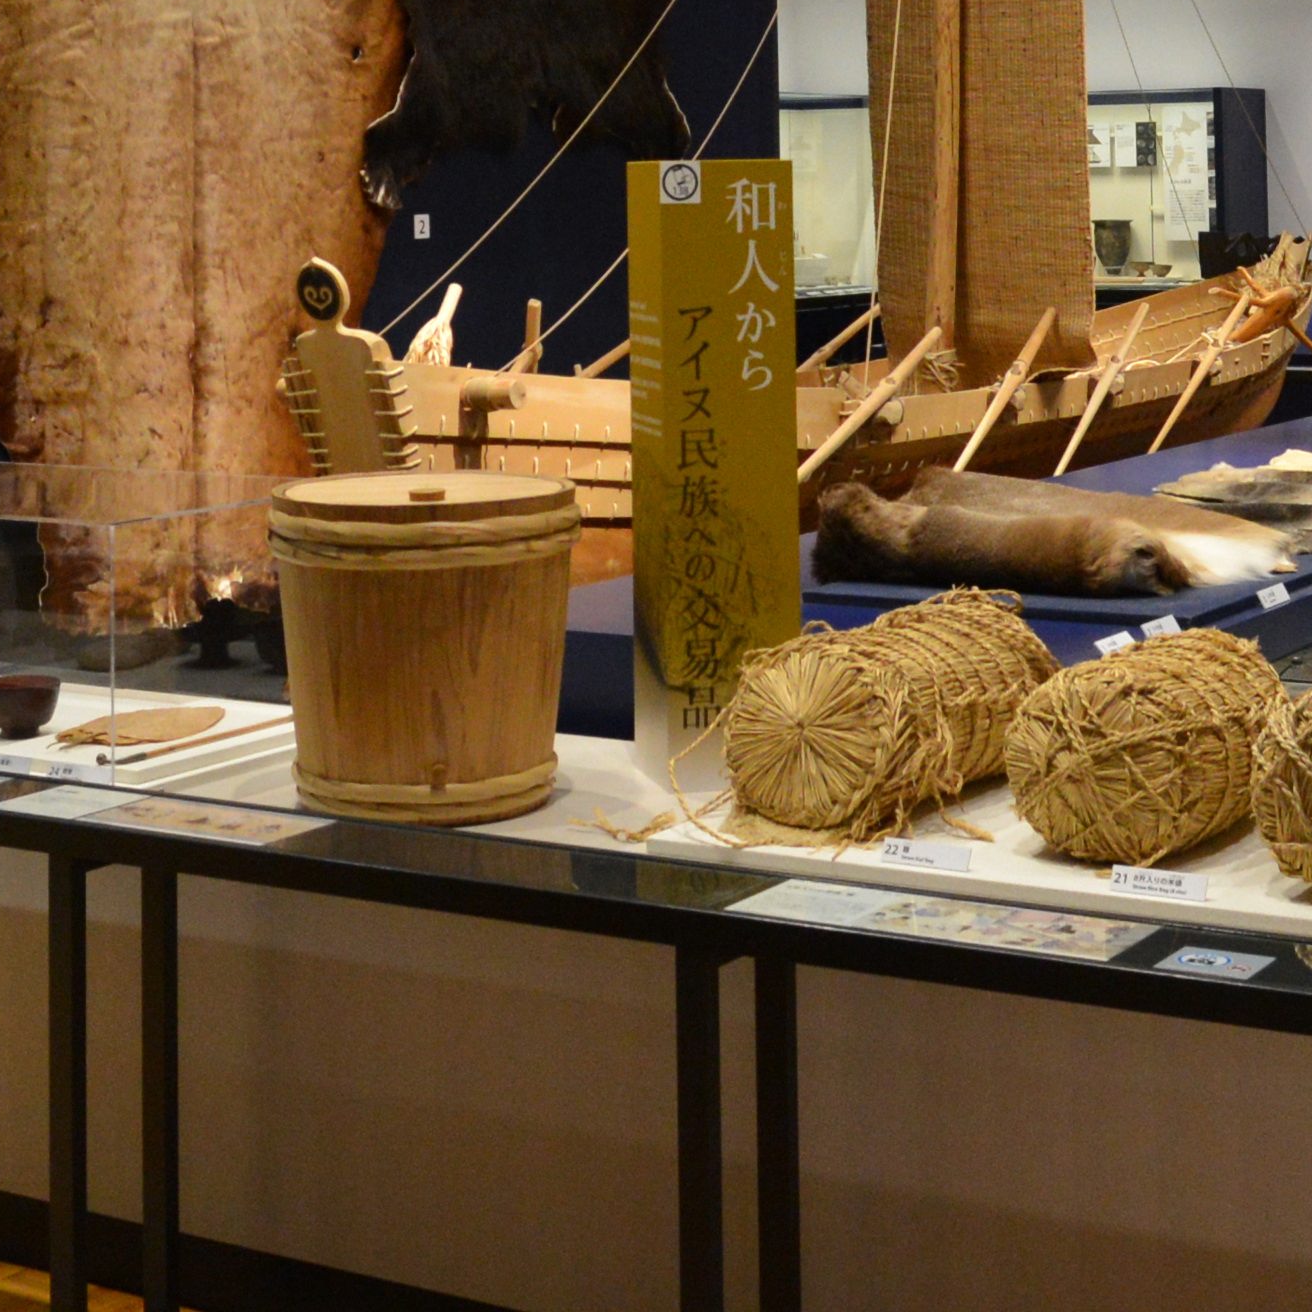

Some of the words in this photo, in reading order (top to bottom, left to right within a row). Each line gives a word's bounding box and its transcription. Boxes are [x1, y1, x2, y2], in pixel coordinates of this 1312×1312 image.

[418, 219, 426, 235] 2
[725, 177, 780, 391] 和人から
[676, 305, 723, 730] アイヌ民族への交易品
[884, 844, 899, 856] 22
[1113, 872, 1128, 885] 21
